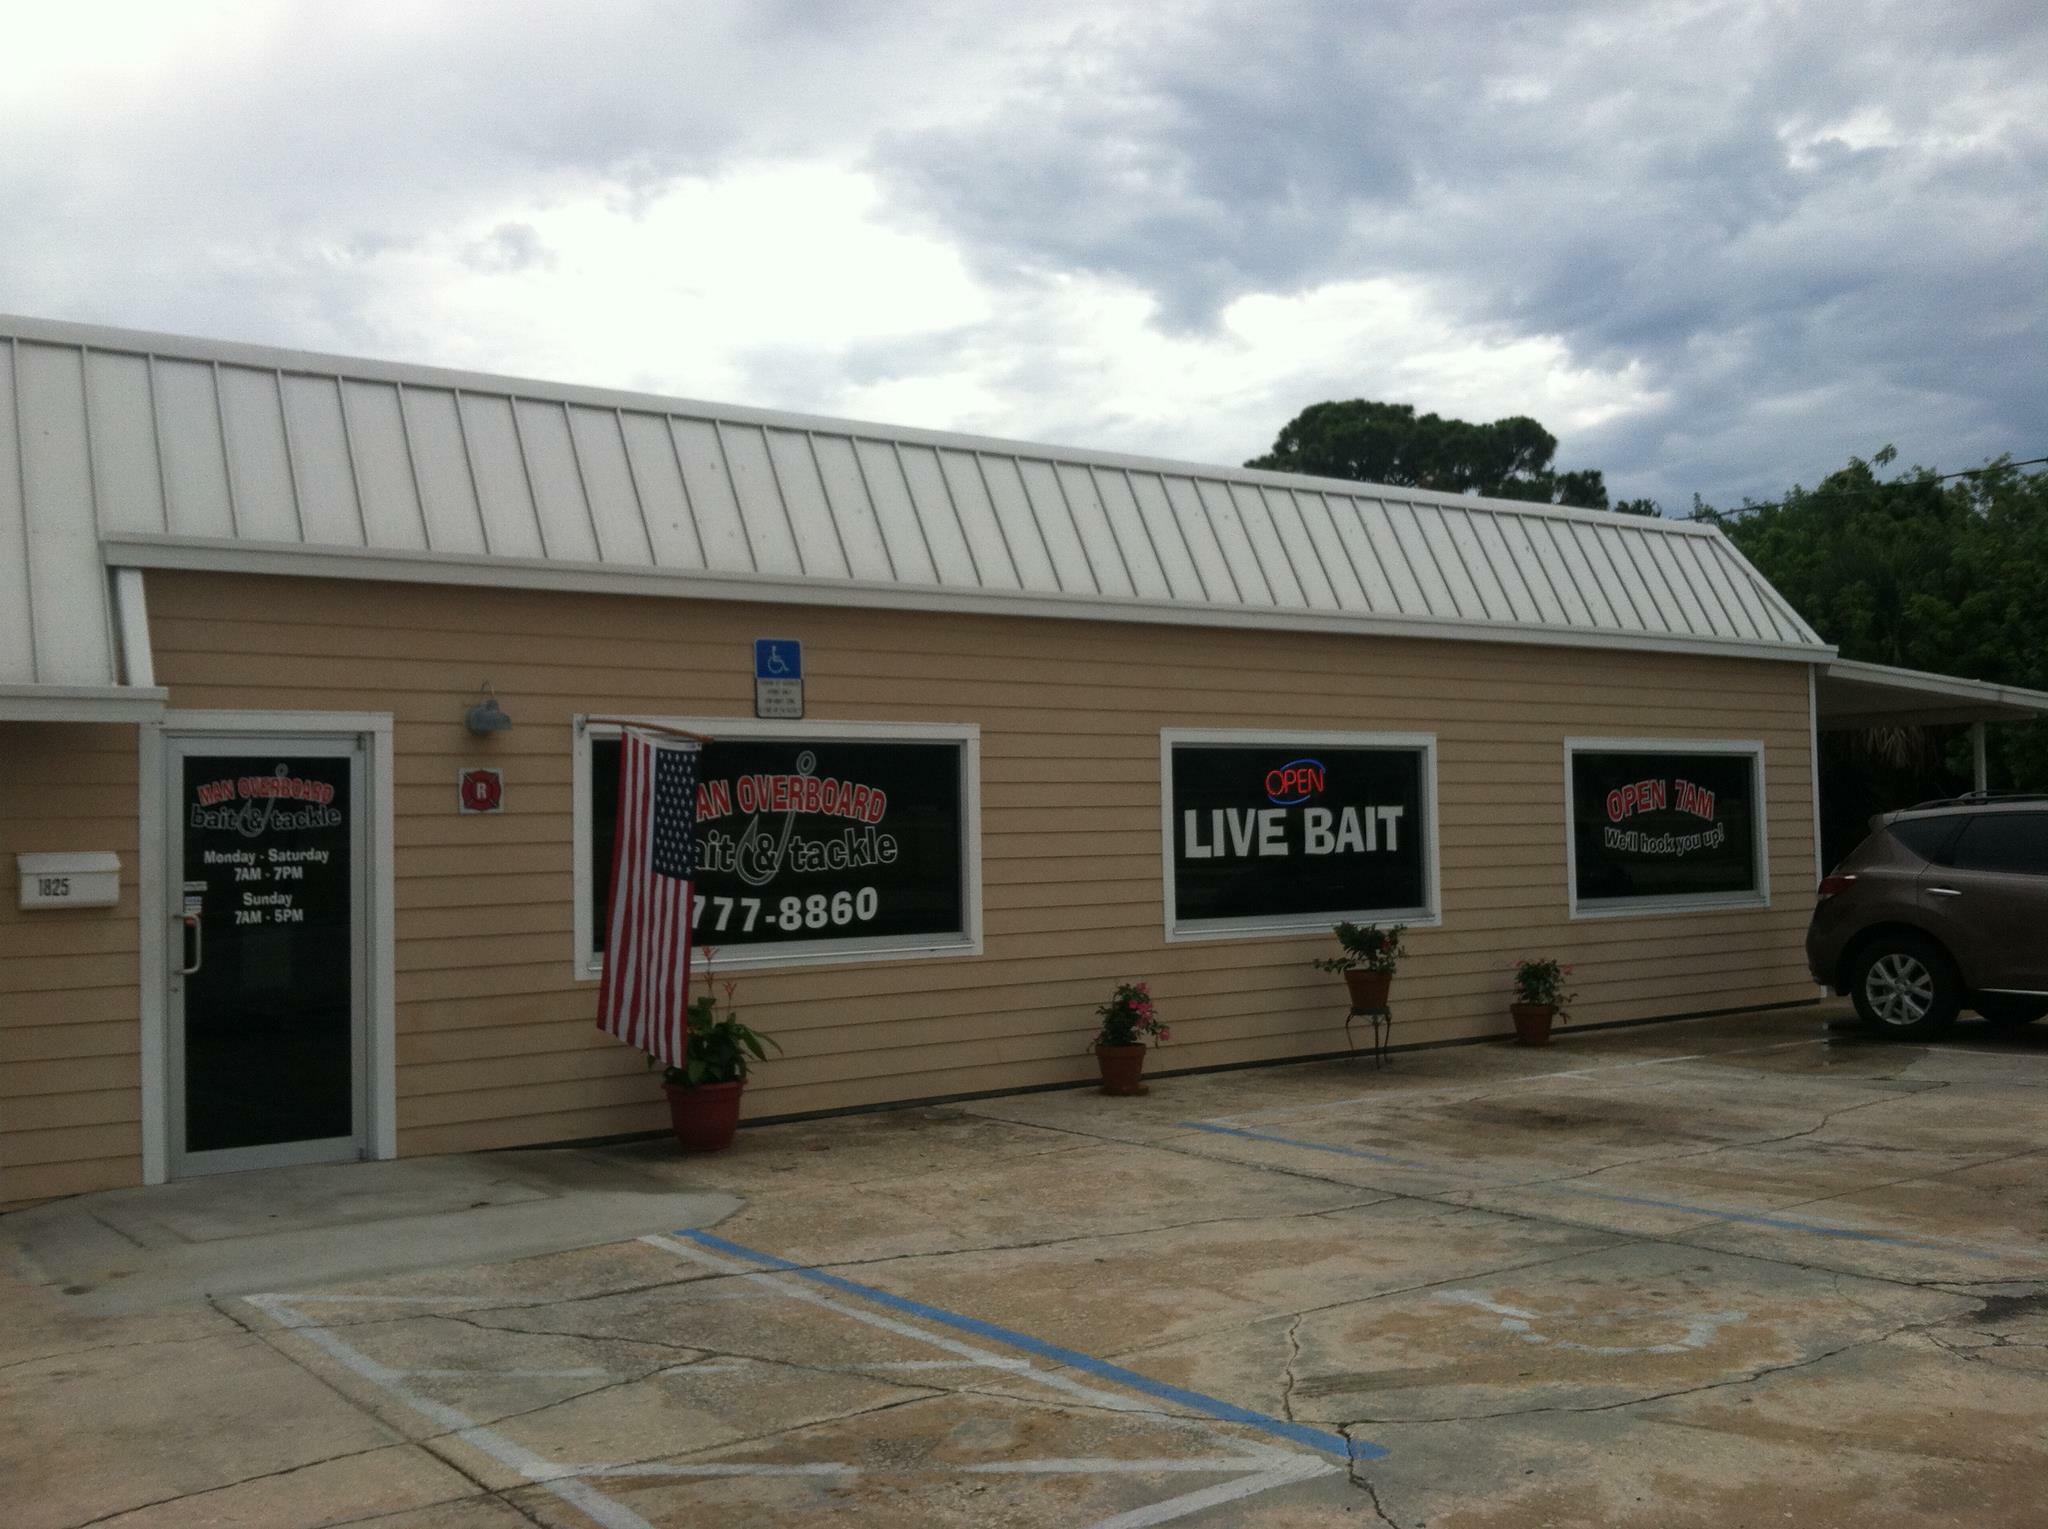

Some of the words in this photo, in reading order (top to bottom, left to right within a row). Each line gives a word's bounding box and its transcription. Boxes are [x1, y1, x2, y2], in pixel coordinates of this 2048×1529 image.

[197, 779, 235, 807] MAN
[237, 776, 335, 805] OVERBOARD
[476, 782, 487, 800] R
[1265, 768, 1324, 795] OPEN
[695, 779, 733, 823] AN
[736, 775, 887, 824] OVERBOARD
[1606, 779, 1666, 822] OPEN
[1674, 778, 1715, 821] 7AM
[192, 803, 237, 830] bait
[247, 808, 263, 830] &
[270, 804, 342, 831] tackle
[1184, 807, 1288, 858] LIVE
[1304, 805, 1403, 855] BAIT
[1640, 832, 1675, 853] hook
[1676, 832, 1701, 857] you
[1702, 822, 1725, 848] up!
[204, 849, 255, 865] Monday
[268, 848, 329, 864] Saturday
[753, 833, 779, 873] &
[788, 826, 898, 873] tackle
[38, 878, 72, 896] 1825
[234, 867, 262, 881] 7AM
[273, 866, 304, 880] 7PM
[242, 891, 293, 907] Sunday
[234, 910, 262, 924] 7AM
[274, 908, 304, 922] 5PM
